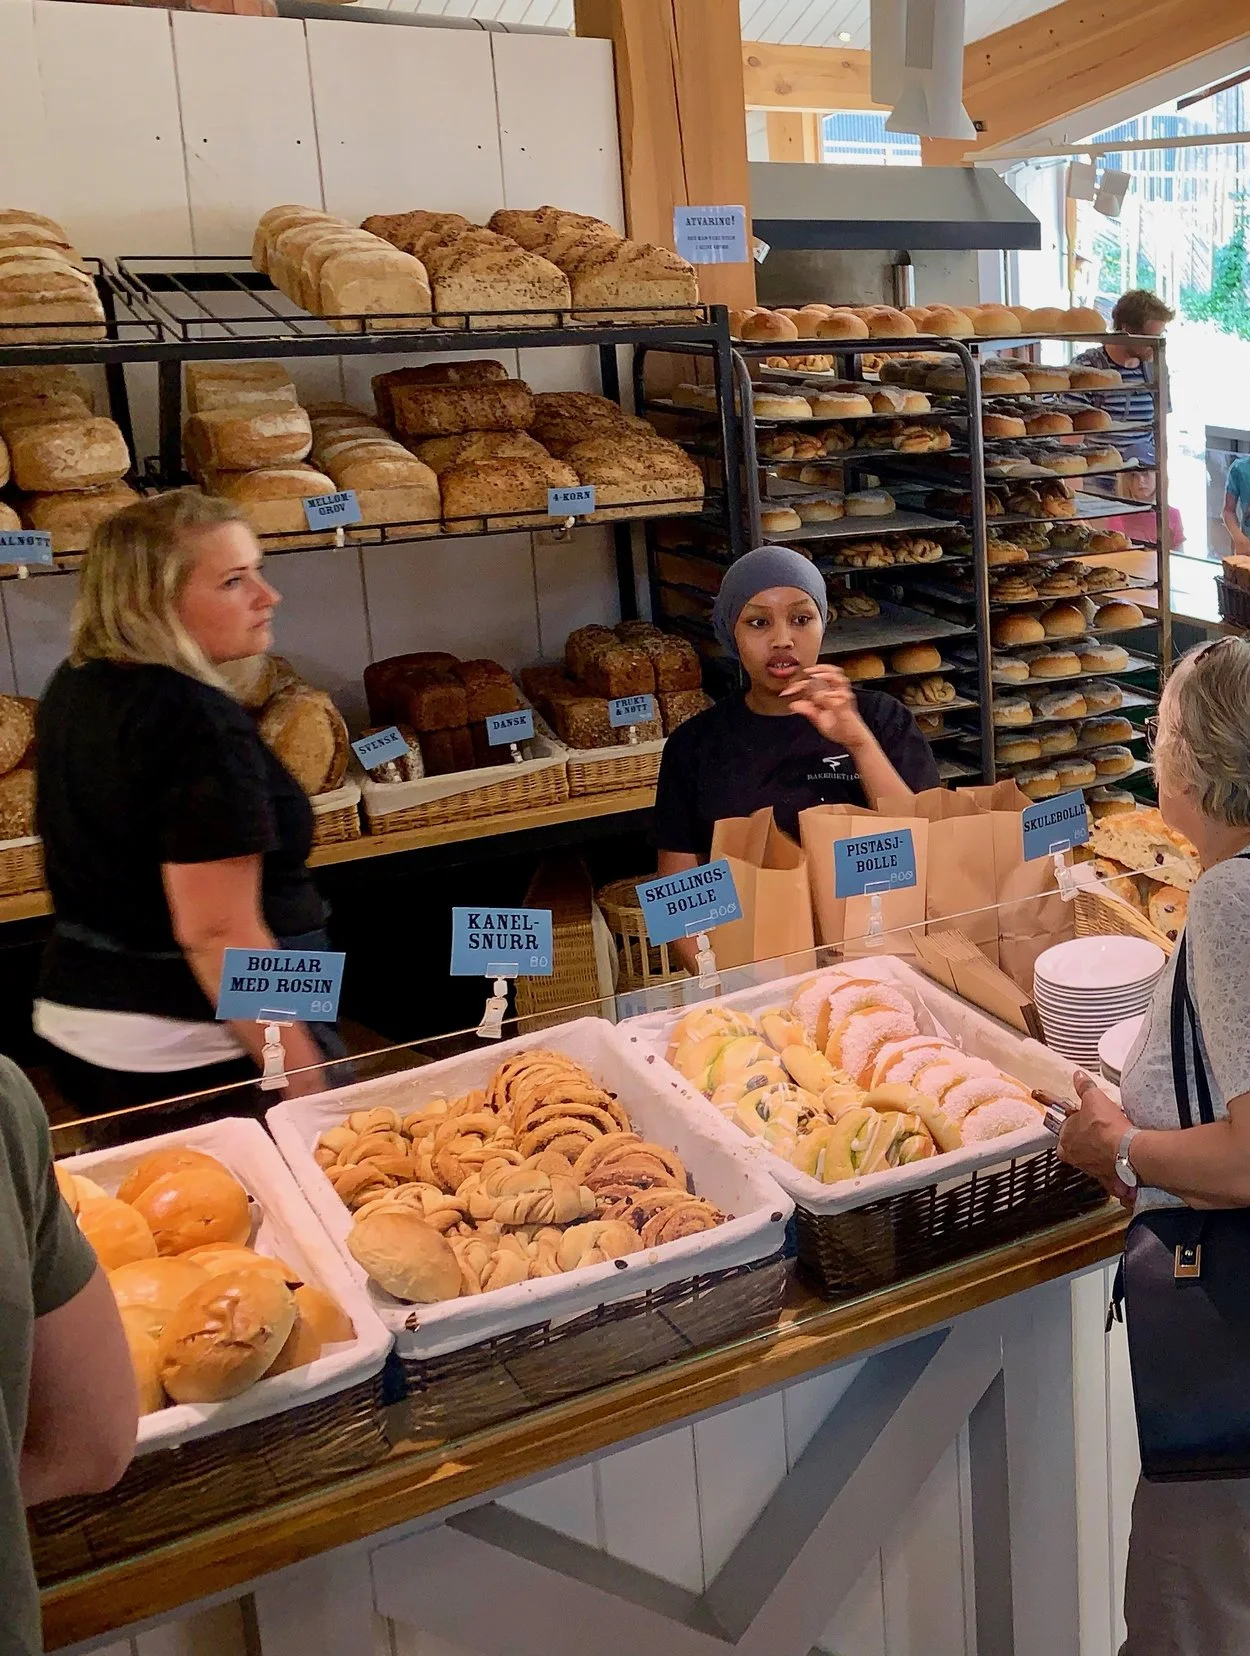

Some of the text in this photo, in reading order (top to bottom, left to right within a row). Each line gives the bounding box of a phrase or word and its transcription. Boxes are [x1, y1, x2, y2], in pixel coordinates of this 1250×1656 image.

[685, 215, 736, 227] ATVARING!
[307, 492, 353, 508] MELLOM-
[552, 491, 591, 502] 4-KORN
[318, 503, 346, 516] GROV
[615, 696, 646, 709] FRUKT
[624, 703, 648, 715] NØTT
[493, 715, 527, 730] DANSK
[358, 732, 399, 755] SVENSK
[1023, 803, 1087, 833] SKULEBOLLE
[846, 836, 904, 857] PISTASJ-
[855, 854, 898, 873] BOLLE
[645, 867, 727, 903] SKILLINGS-
[665, 888, 717, 916] BOLLE
[467, 913, 540, 931] KANEL-
[468, 933, 539, 950] SNURR
[246, 956, 322, 973] BOLLAR
[229, 976, 333, 994] MED ROSIN
